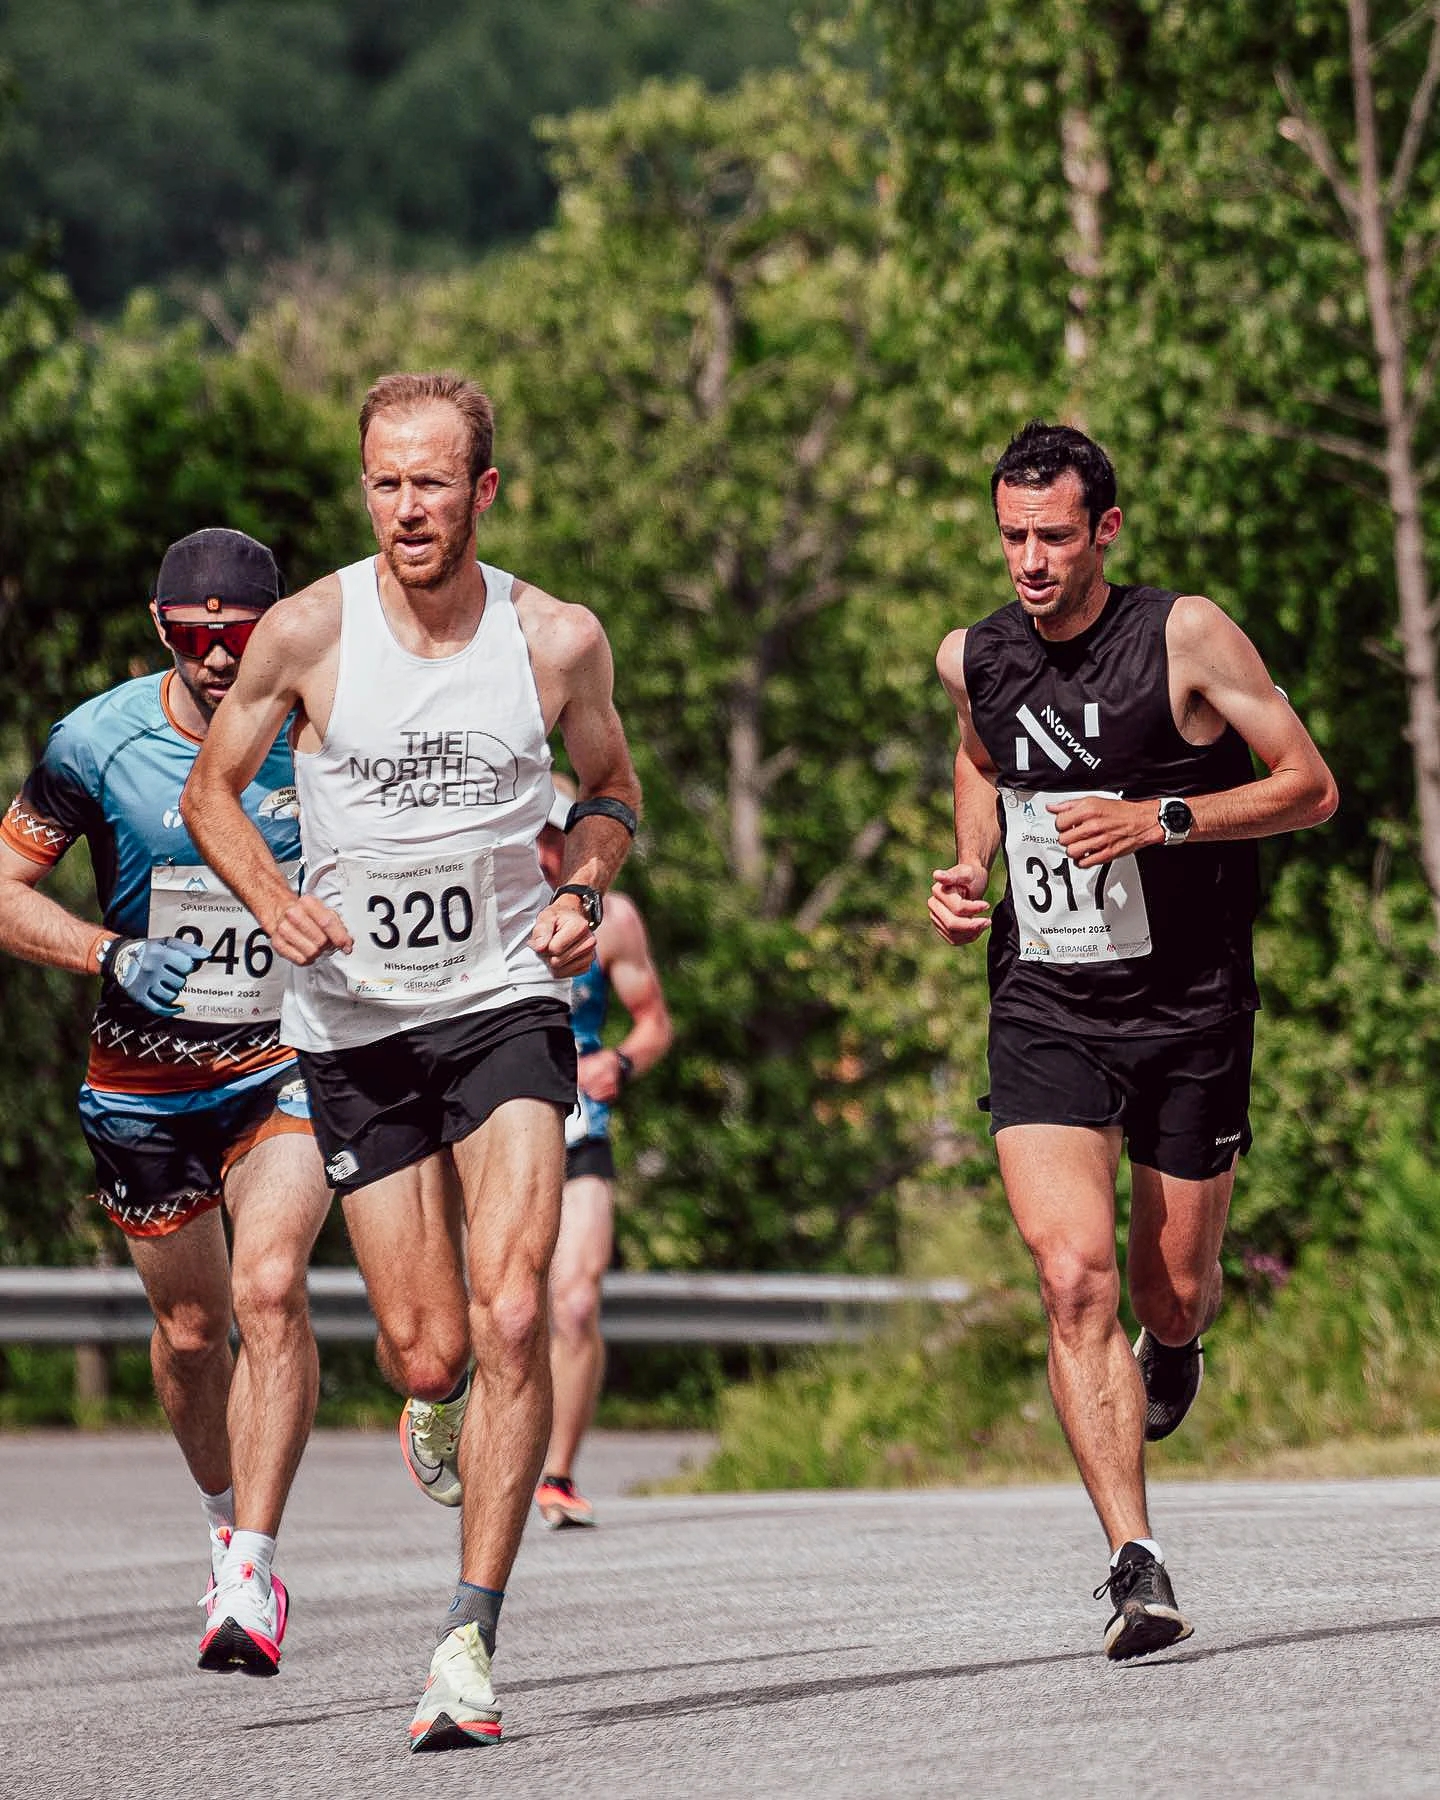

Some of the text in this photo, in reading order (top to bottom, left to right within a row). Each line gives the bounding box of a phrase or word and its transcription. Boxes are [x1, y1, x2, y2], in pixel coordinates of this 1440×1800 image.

[400, 731, 463, 756] THE
[349, 756, 463, 784] NORTH
[380, 781, 462, 808] FACE
[1025, 856, 1114, 914] 317
[367, 885, 474, 950] 320
[1087, 924, 1113, 935] 2022
[441, 954, 467, 969] 2022
[236, 989, 262, 999] 2022
